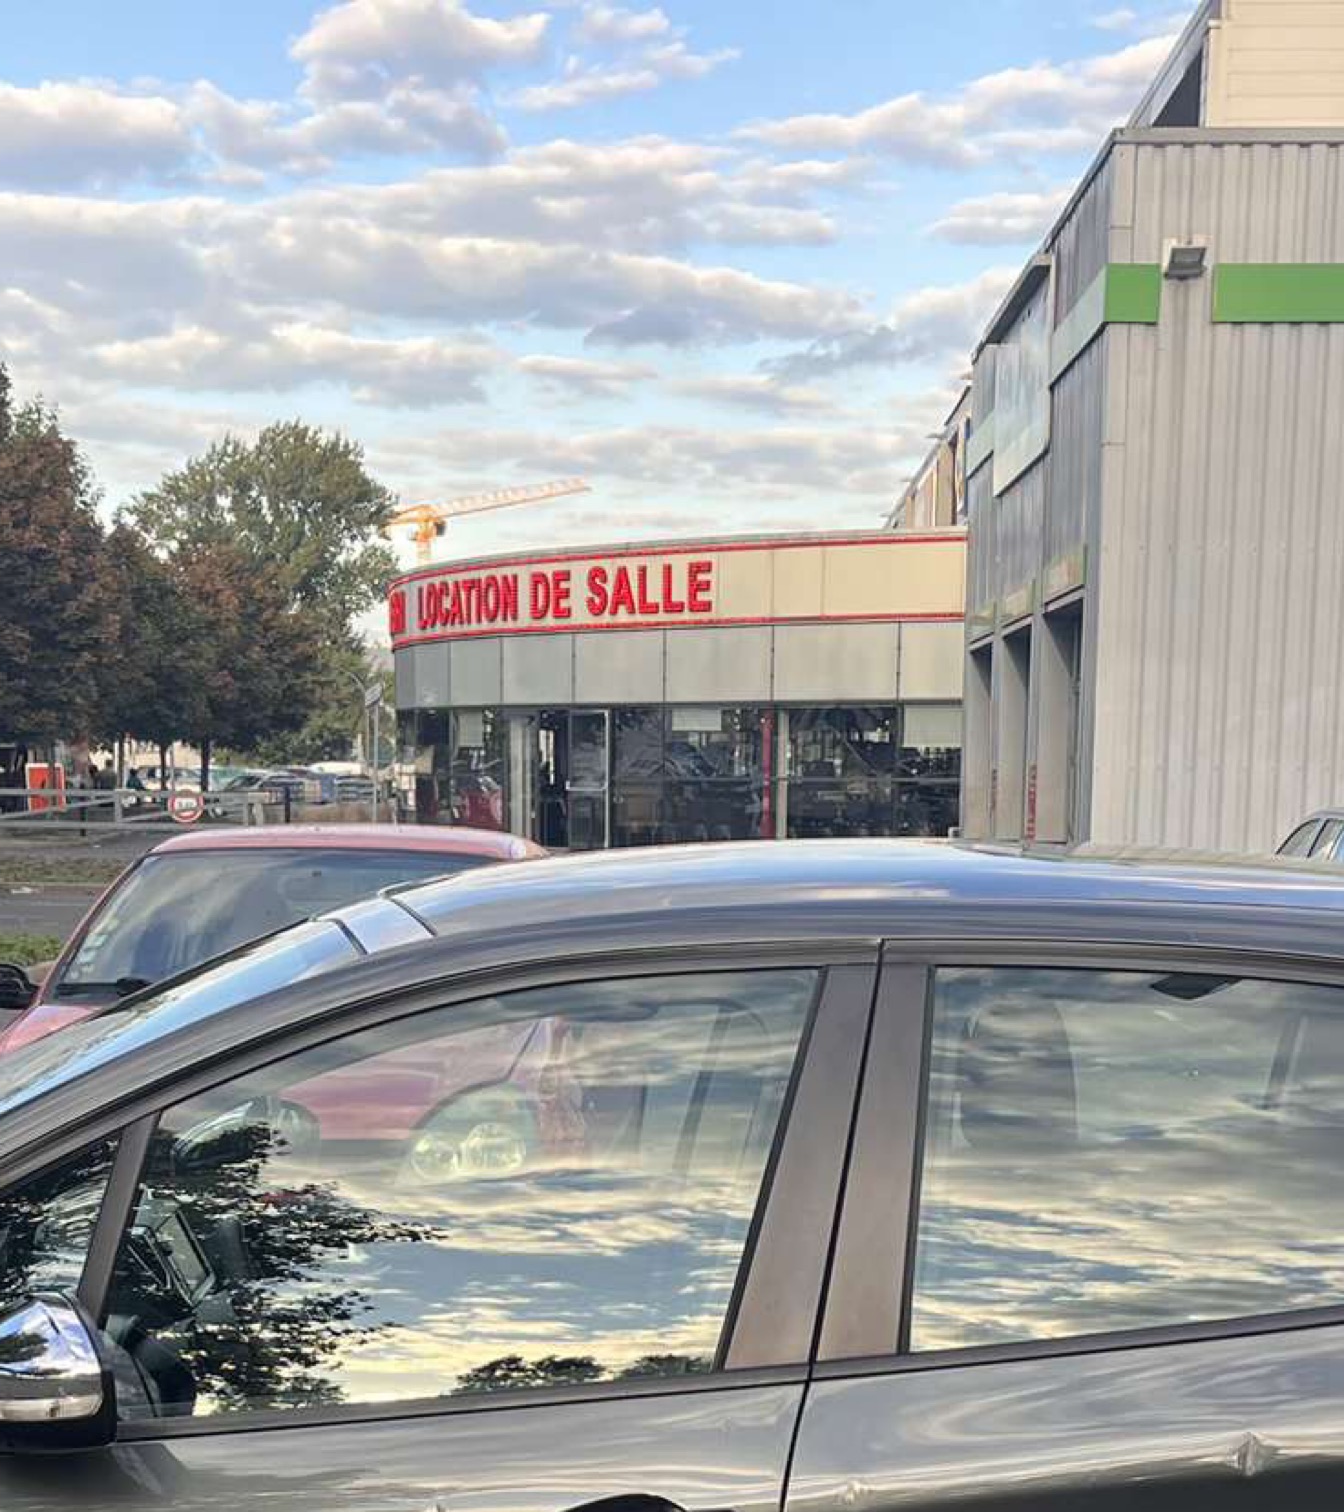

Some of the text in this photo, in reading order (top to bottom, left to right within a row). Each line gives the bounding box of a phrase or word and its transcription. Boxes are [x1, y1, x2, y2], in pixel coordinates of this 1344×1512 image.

[418, 574, 519, 631] LOCATION
[530, 570, 572, 620] DE
[586, 561, 713, 617] SALLE
